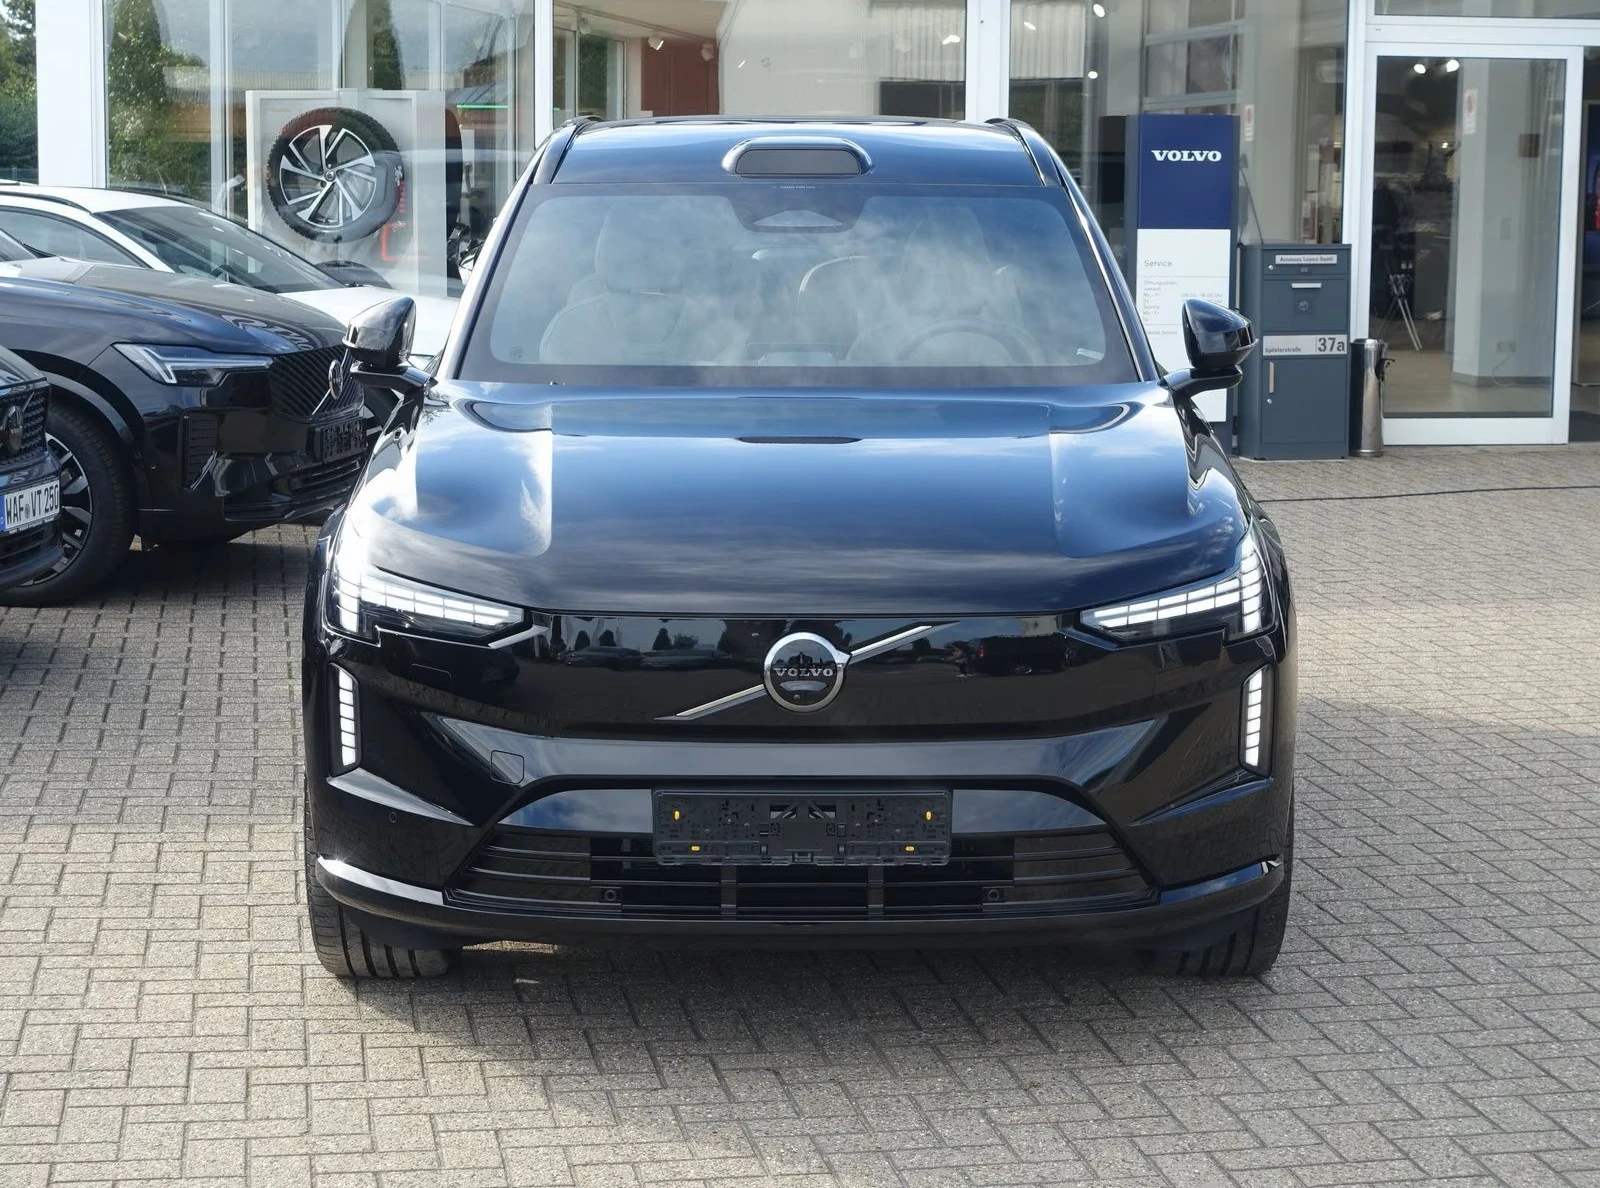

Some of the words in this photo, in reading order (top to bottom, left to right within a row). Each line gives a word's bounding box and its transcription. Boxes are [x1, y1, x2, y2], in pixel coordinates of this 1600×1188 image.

[1151, 150, 1222, 161] VOLVO
[1144, 259, 1172, 267] Service
[1318, 337, 1345, 353] 37a
[5, 495, 24, 524] WAF
[31, 489, 42, 517] VT
[773, 667, 834, 677] VOLVO
